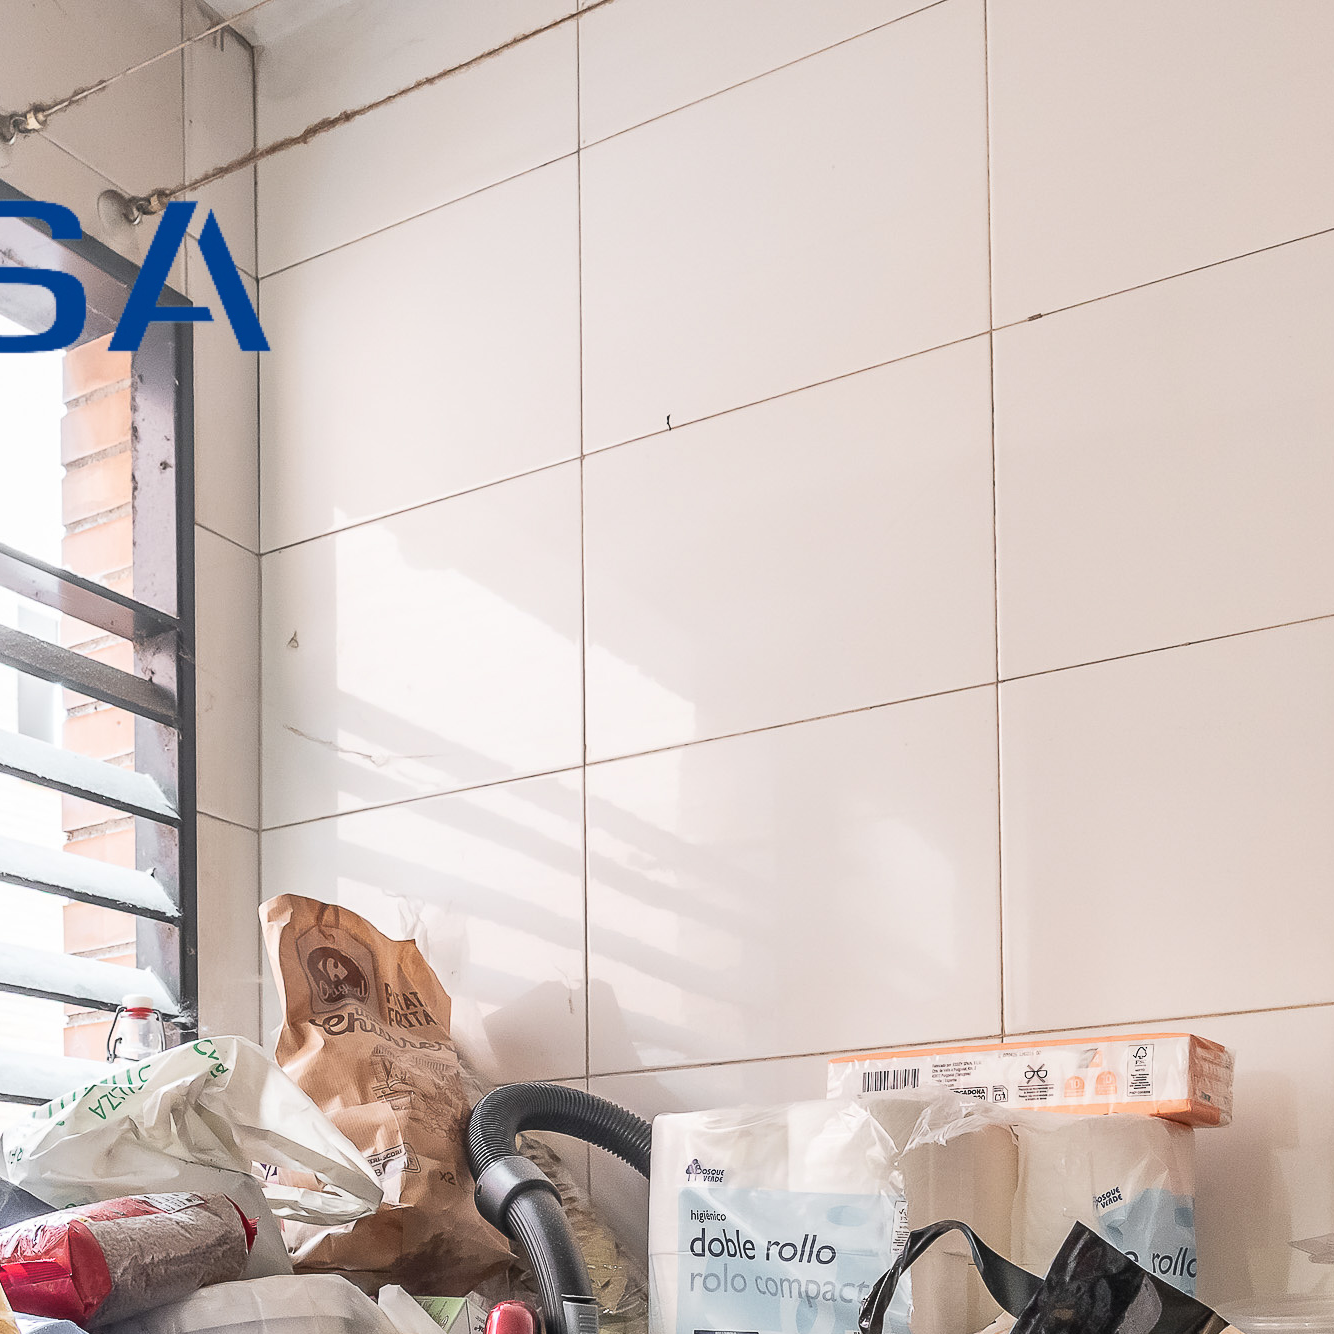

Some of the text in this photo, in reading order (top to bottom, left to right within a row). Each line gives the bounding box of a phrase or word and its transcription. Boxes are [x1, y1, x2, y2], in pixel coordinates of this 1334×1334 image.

[695, 1165, 725, 1176] BOSQUE
[703, 1175, 723, 1183] VERDE
[1100, 1194, 1123, 1208] VERDE
[691, 1210, 727, 1223] higiénico
[690, 1228, 836, 1264] doble rollo
[690, 1263, 747, 1293] rolo
